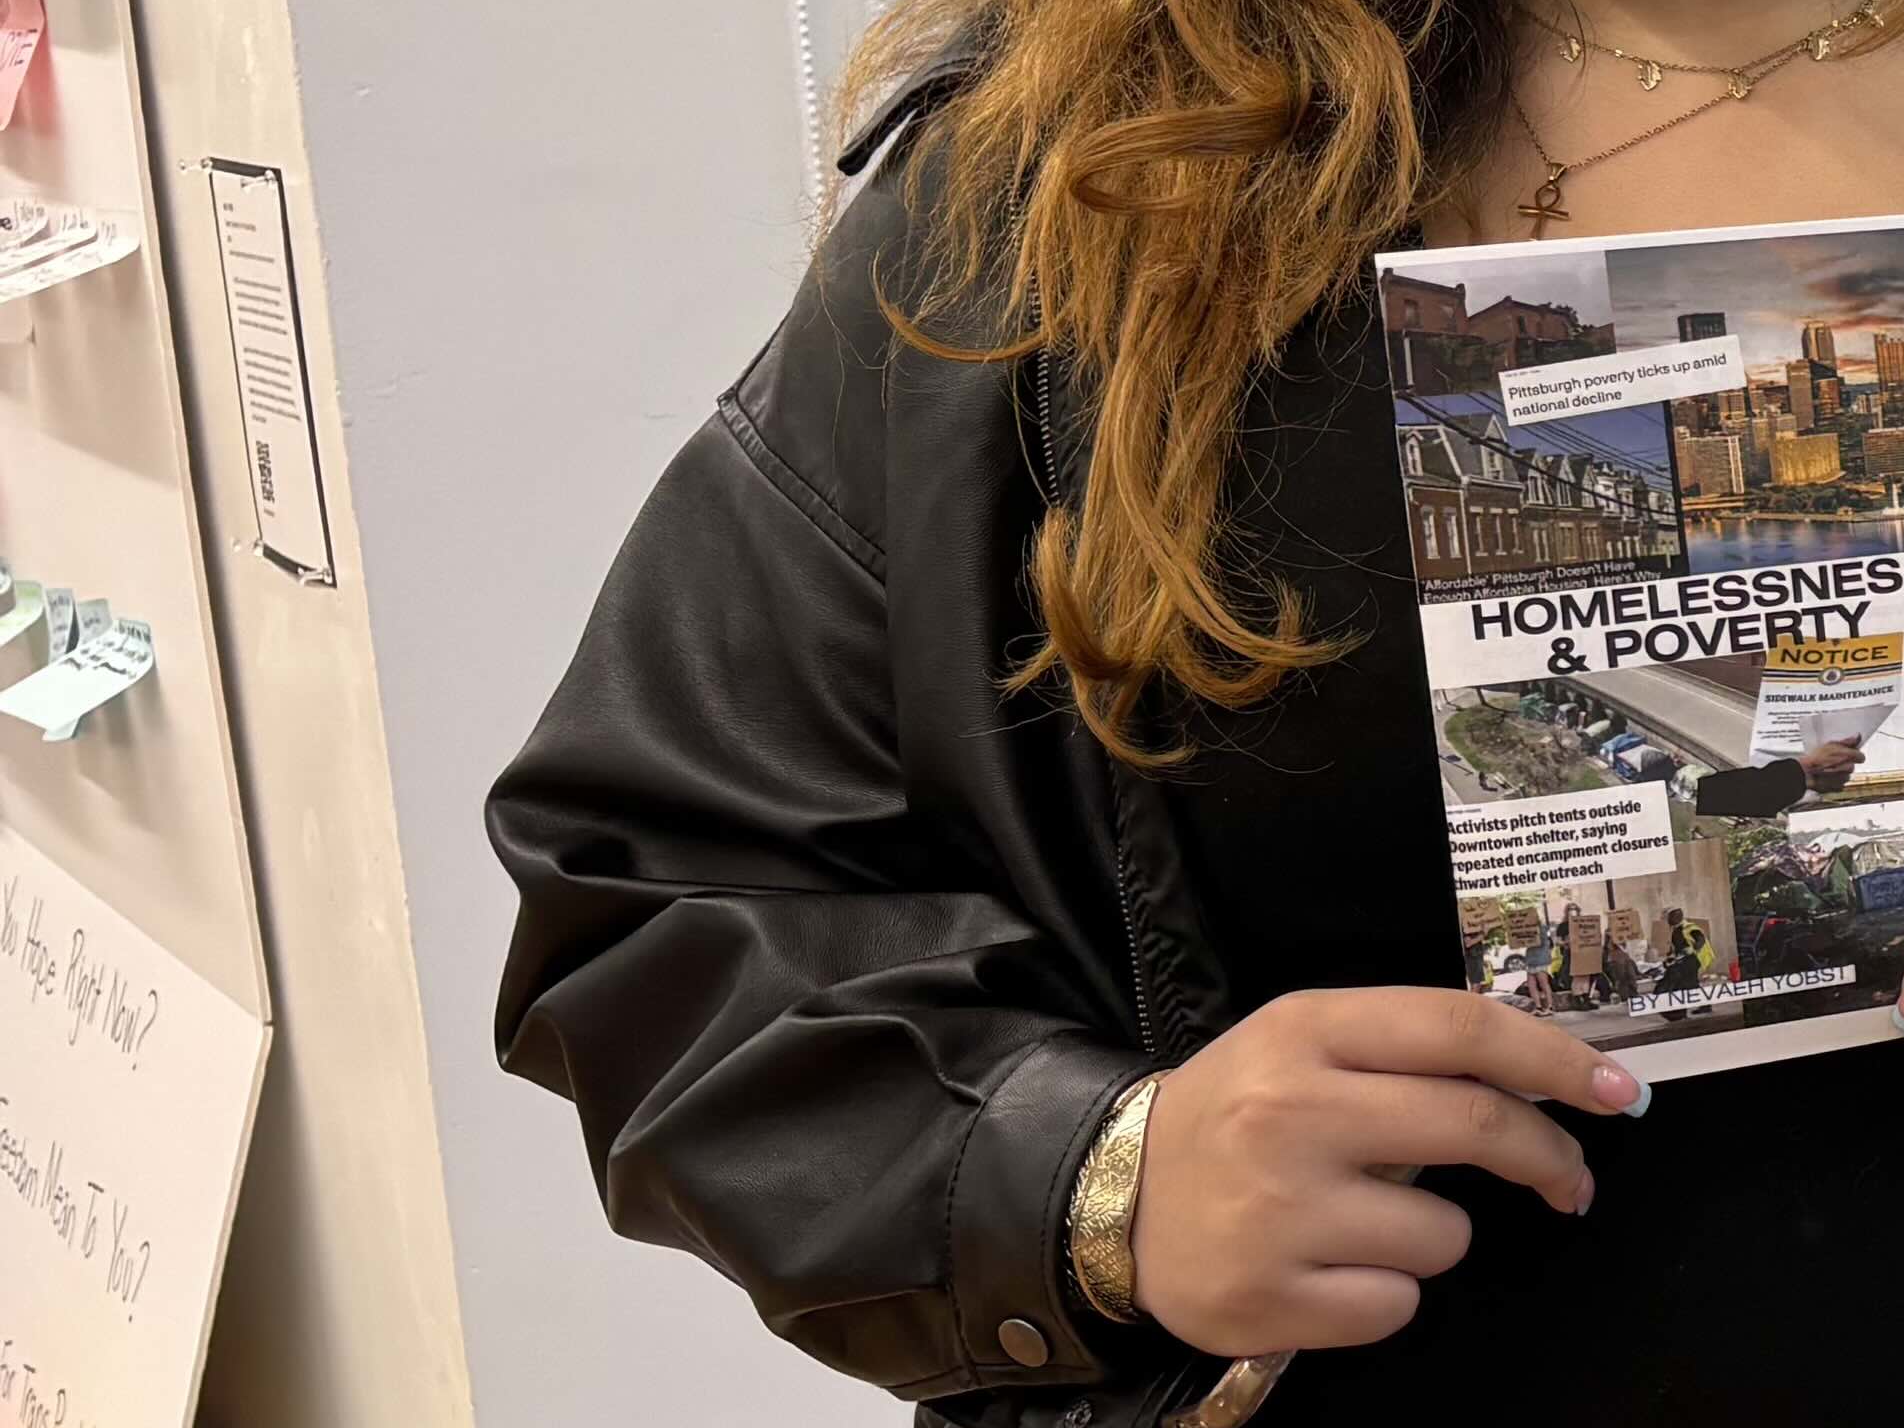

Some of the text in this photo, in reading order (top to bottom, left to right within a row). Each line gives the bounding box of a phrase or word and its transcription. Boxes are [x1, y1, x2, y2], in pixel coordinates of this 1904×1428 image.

[1508, 353, 1728, 400] Pittsburgh poverty ticks up amid
[1512, 389, 1623, 418] national decline
[1474, 584, 1535, 600] Affordable
[1634, 570, 1662, 583] Why
[1492, 570, 1553, 586] Pittsburgh
[1557, 564, 1601, 579] Doesn't
[1604, 561, 1636, 573] Have
[1547, 600, 1872, 676] & POVERTY
[1780, 646, 1889, 664] NOTICE
[1764, 685, 1894, 703] SIDEWALK MAINTENANCE
[1448, 800, 1642, 835] Activists pitch tents outside
[1525, 829, 1580, 846] shelter,
[1581, 821, 1628, 839] saying
[1516, 842, 1609, 864] encampment
[1611, 835, 1669, 853] closures
[1503, 869, 1537, 886] their
[1540, 861, 1604, 881] outreach
[20, 896, 55, 1003] Hope
[63, 928, 104, 1046] Right
[102, 970, 158, 1071] Now?
[1630, 966, 1848, 1012] BY NEVAEH YOBST
[40, 1140, 76, 1250] Mean
[81, 1181, 105, 1259] To
[106, 1197, 150, 1323] You?
